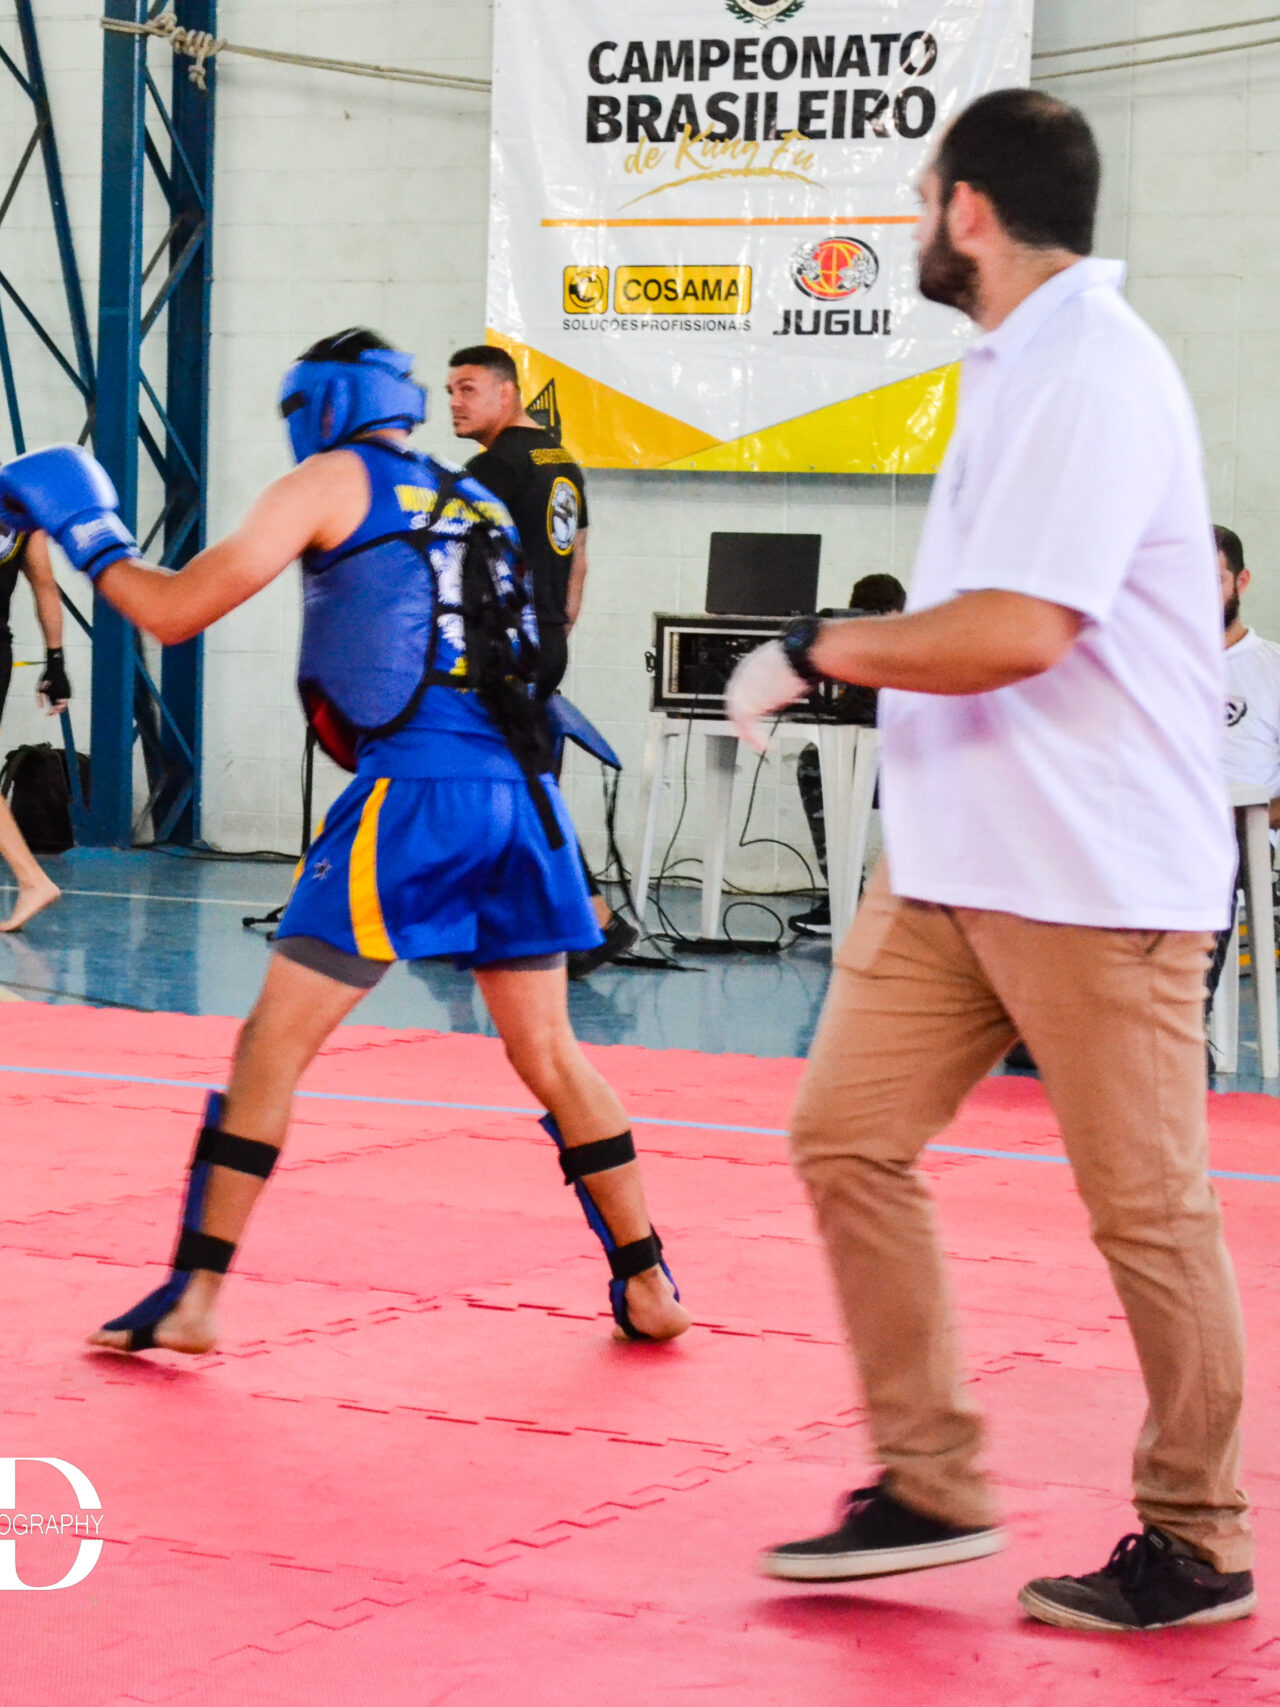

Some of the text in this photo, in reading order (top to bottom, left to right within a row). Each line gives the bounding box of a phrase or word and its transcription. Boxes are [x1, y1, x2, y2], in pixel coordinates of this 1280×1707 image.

[589, 31, 937, 84] CAMPEONATO
[586, 86, 936, 143] BRASILEIRO
[624, 122, 817, 174] de Kung Fu
[624, 279, 739, 302] COSAMA
[773, 310, 891, 336] JUGUI
